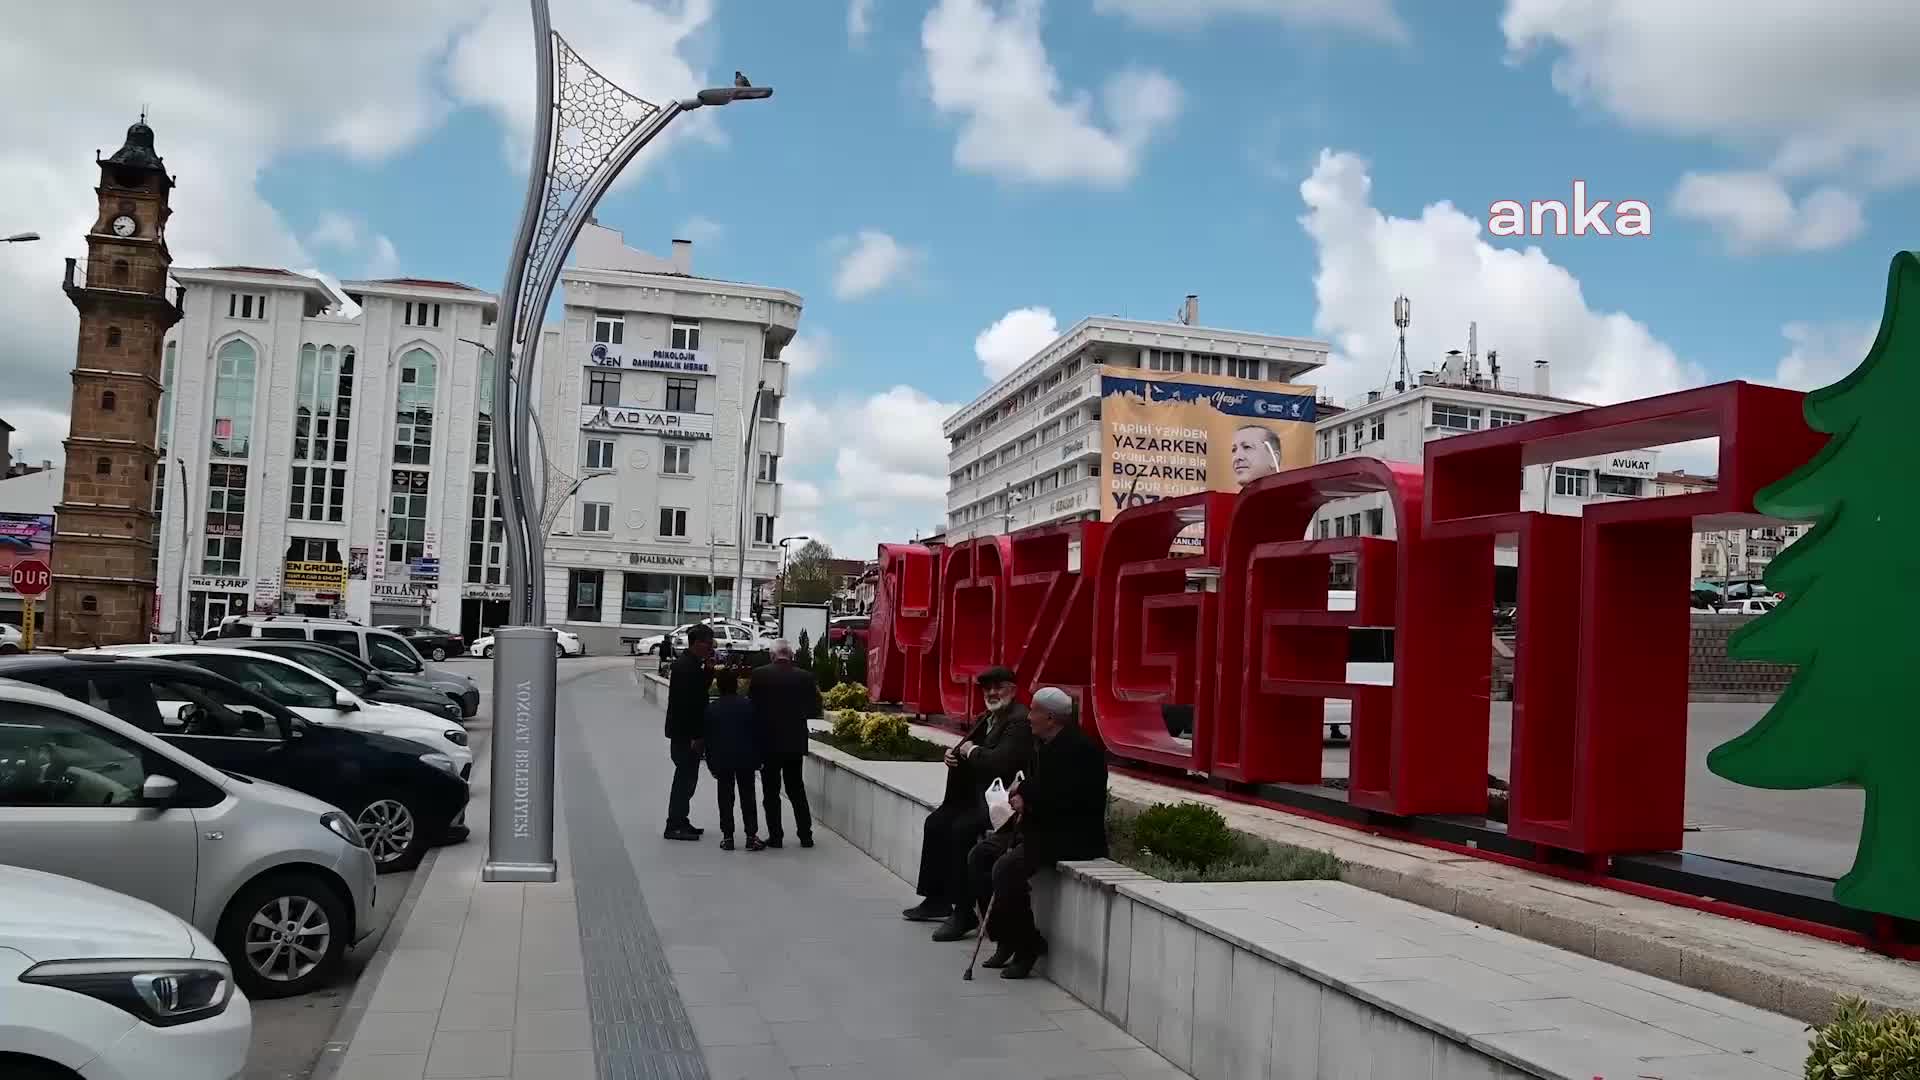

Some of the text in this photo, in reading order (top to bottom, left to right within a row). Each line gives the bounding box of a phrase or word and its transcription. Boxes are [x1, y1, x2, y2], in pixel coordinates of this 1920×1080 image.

[614, 411, 640, 423] AD
[1112, 434, 1207, 455] YAZARKEN
[1613, 458, 1650, 470] AVUKAT
[1113, 461, 1207, 482] BOZARKEN
[304, 564, 342, 572] GROUP
[14, 569, 48, 585] DUR
[215, 579, 248, 589] EŞARP
[515, 680, 531, 744] YOZGAT
